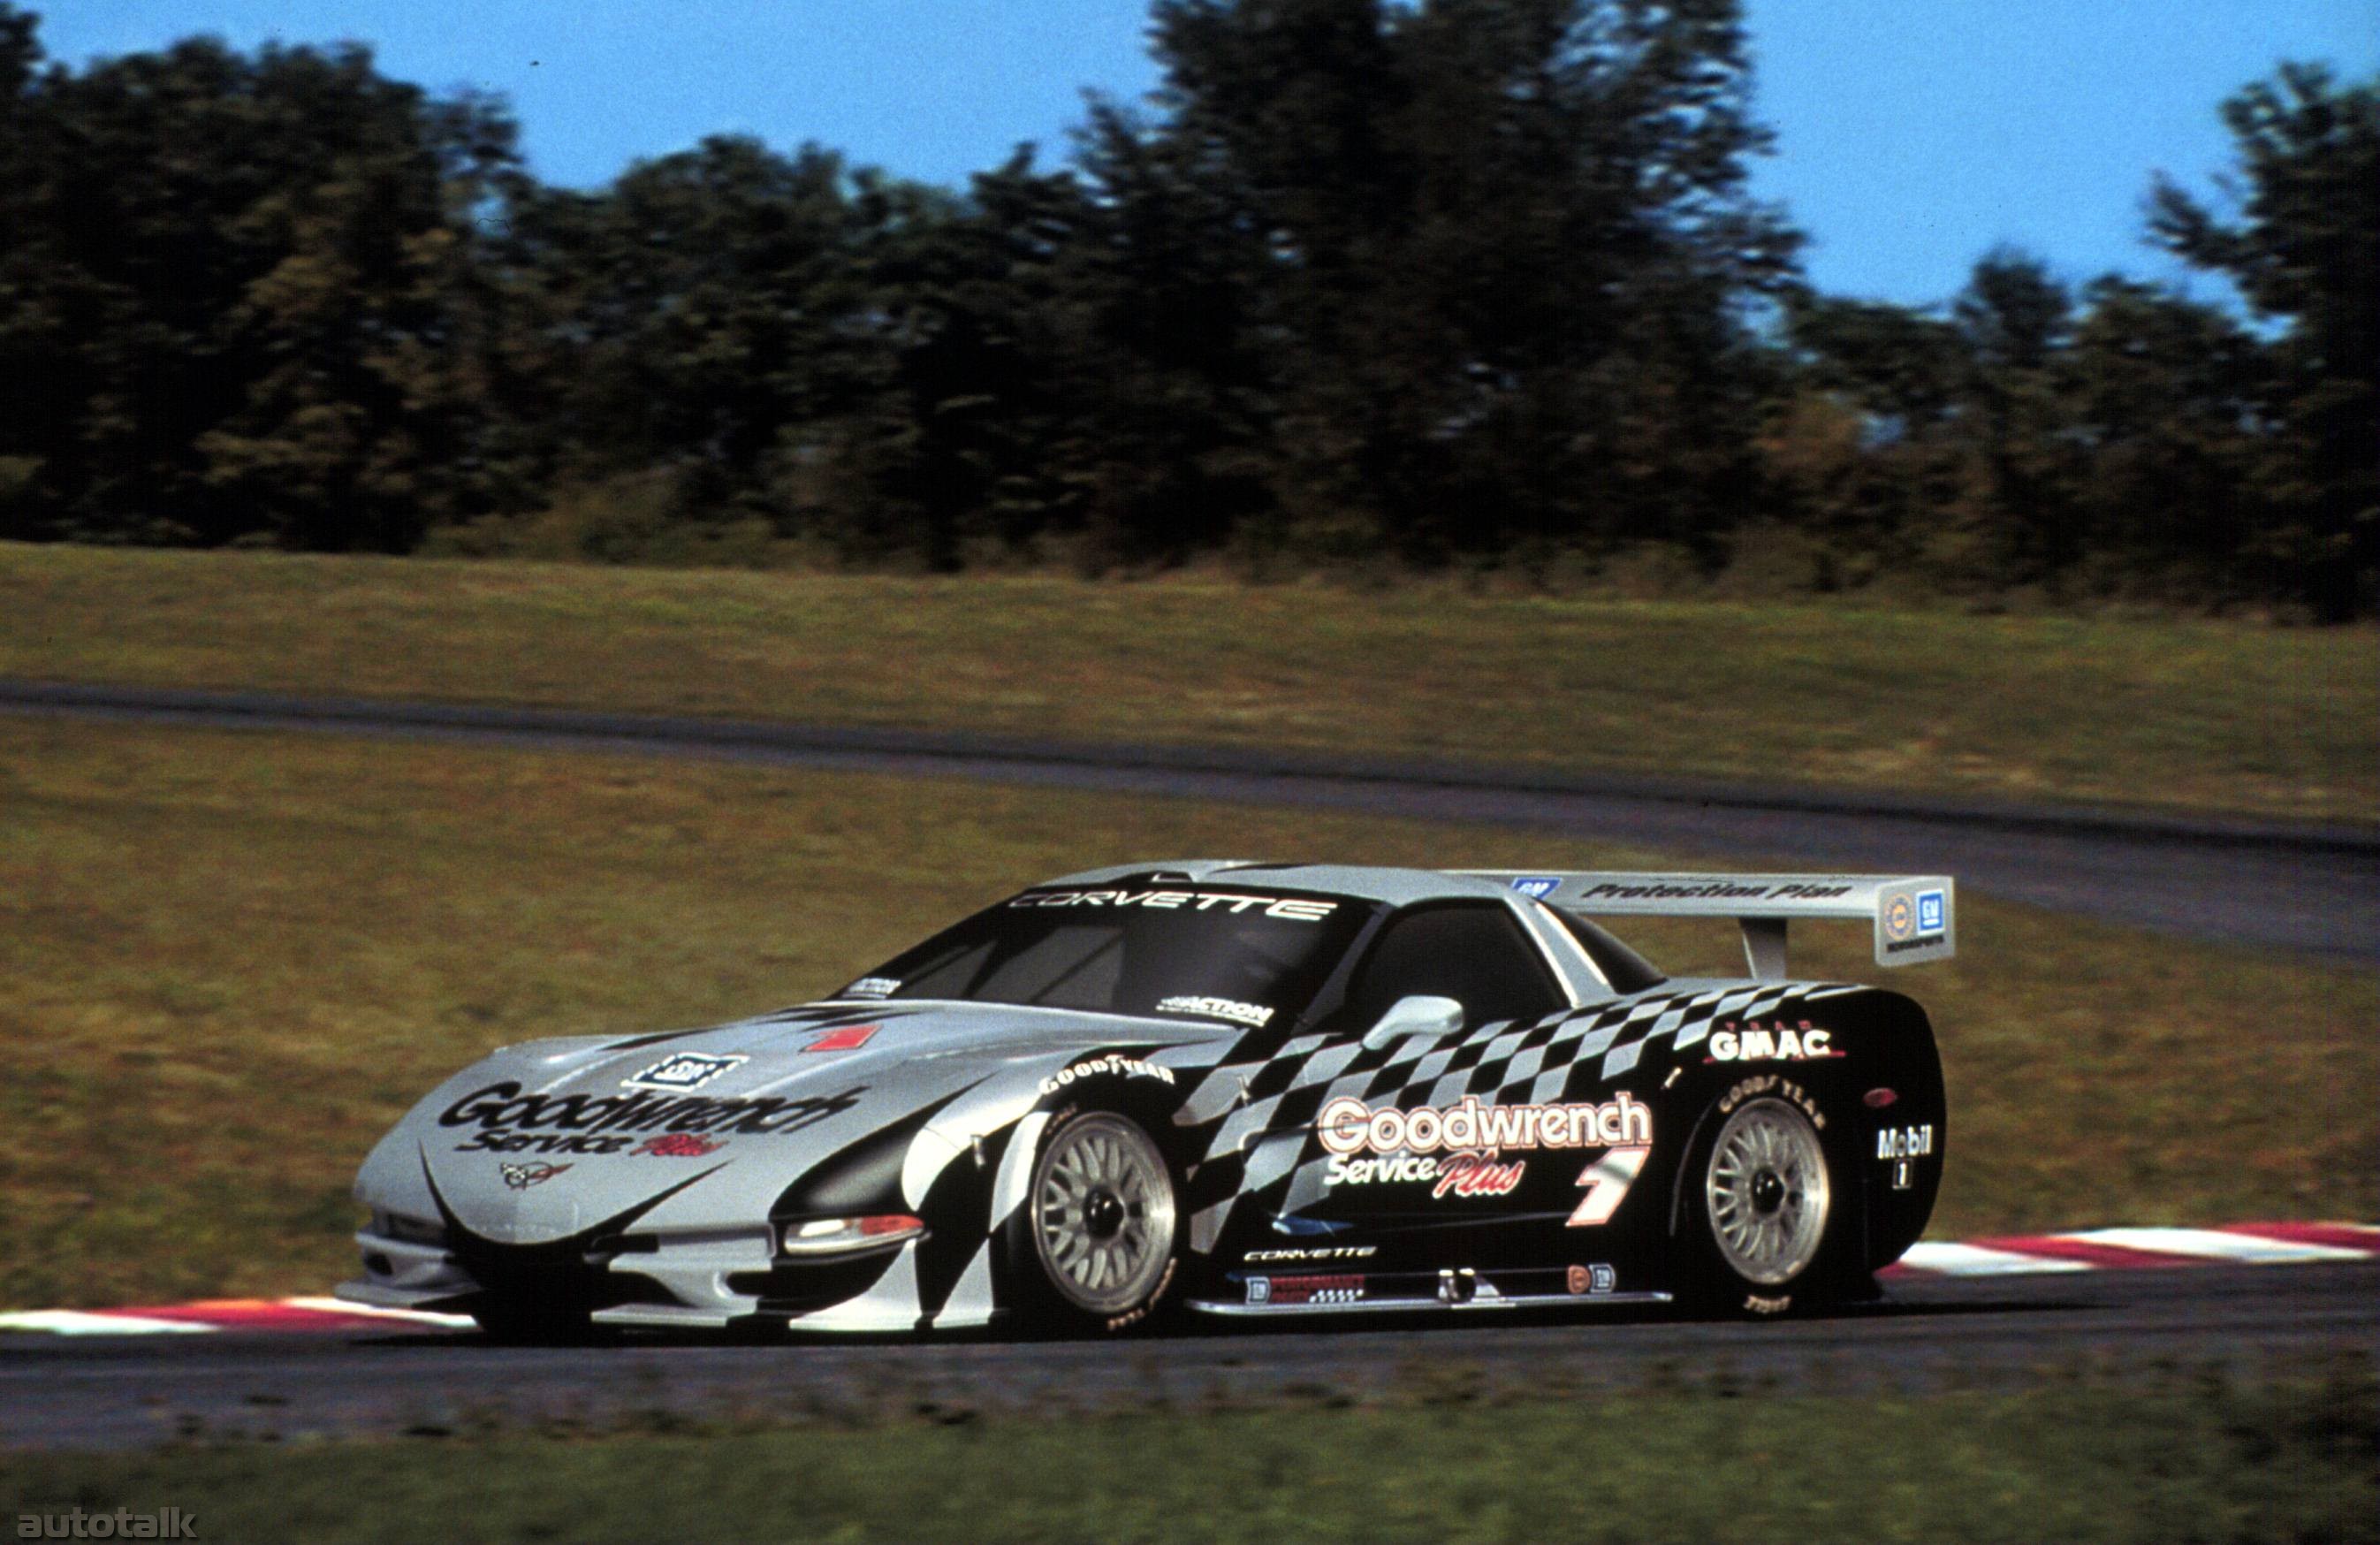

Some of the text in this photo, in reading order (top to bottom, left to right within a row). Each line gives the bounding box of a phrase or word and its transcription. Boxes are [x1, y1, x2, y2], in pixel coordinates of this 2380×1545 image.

[1008, 890, 1338, 921] CORVETTE
[1581, 884, 1852, 899] Protection Plan
[1709, 1029, 1831, 1061] GMAC
[438, 1081, 871, 1135] Goodwrench
[1318, 1091, 1653, 1154] Goodwrench
[452, 1128, 635, 1153] Service
[1877, 1124, 1933, 1160] Mobil
[1323, 1146, 1526, 1199] Service Plus
[1243, 1246, 1377, 1261] CORVETTE
